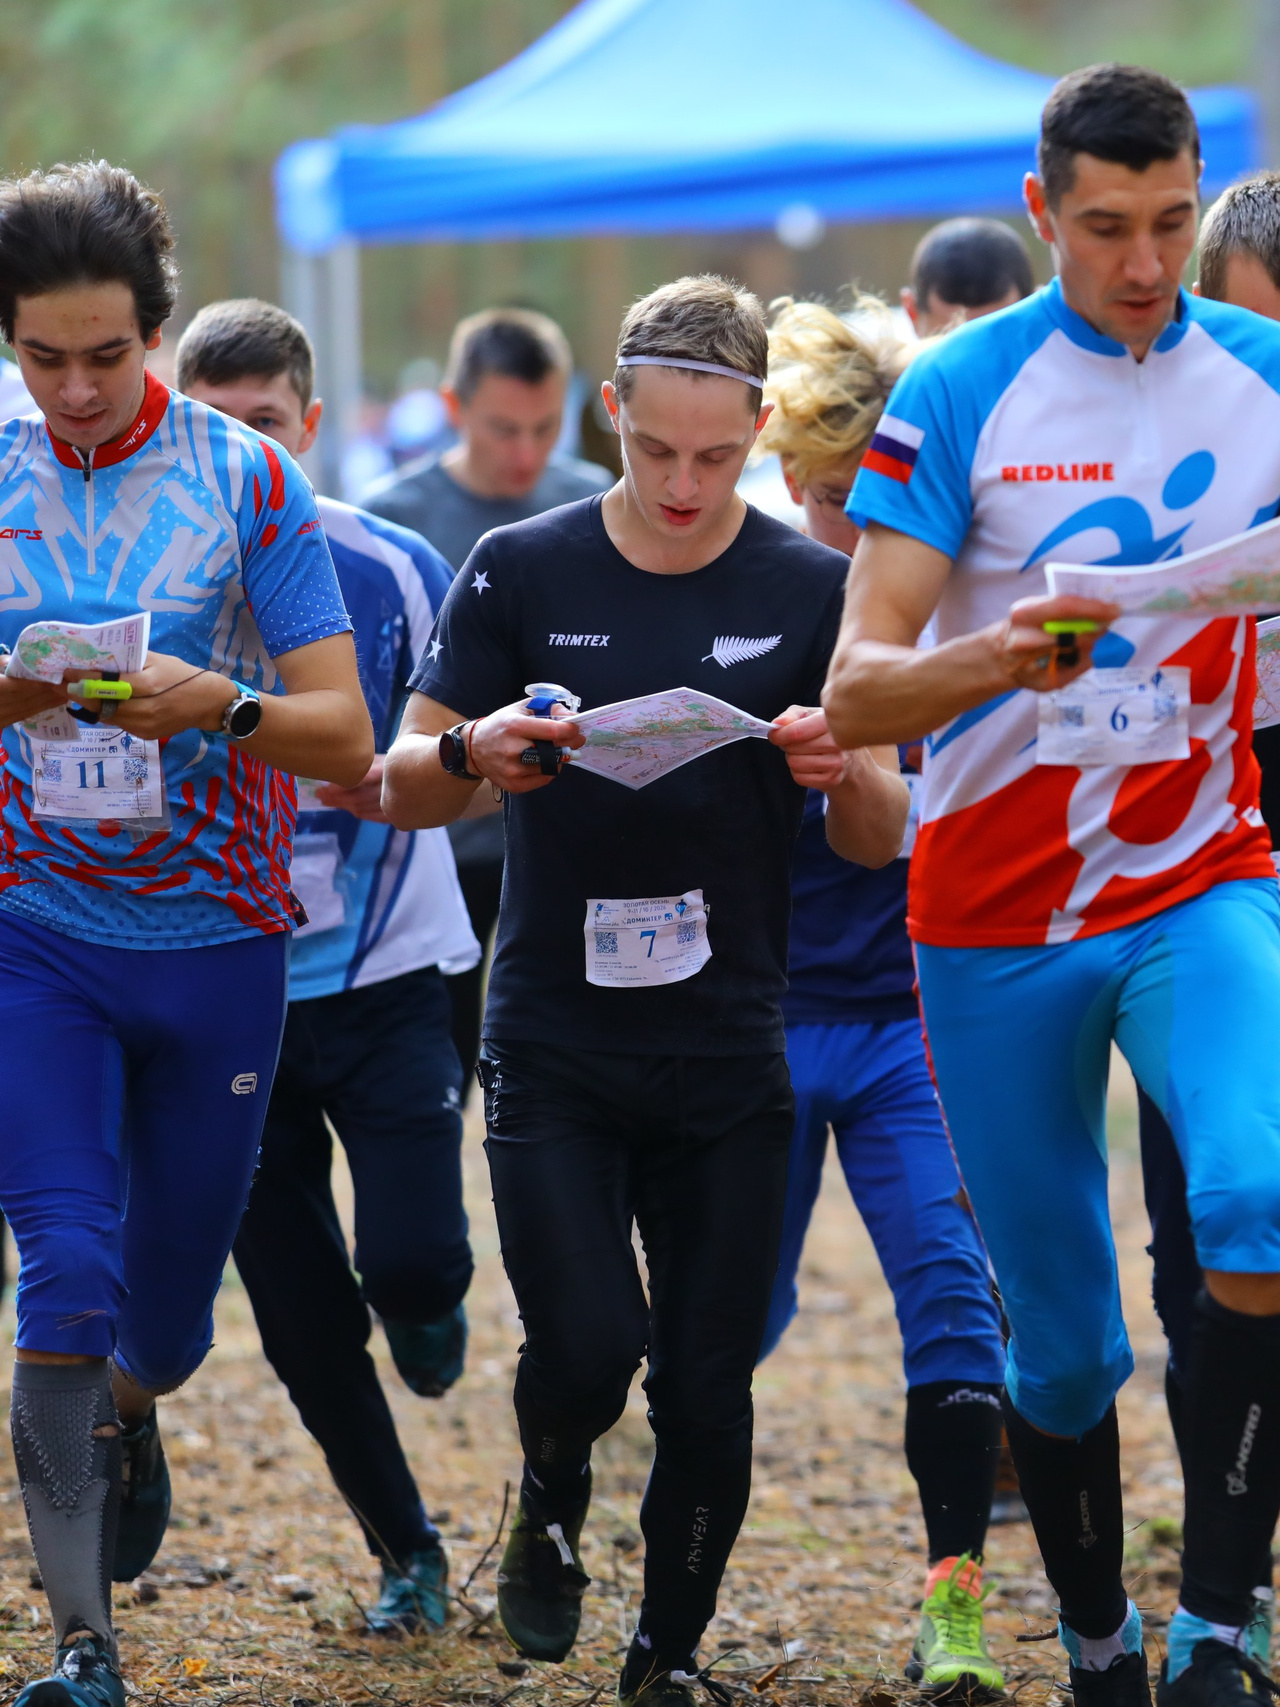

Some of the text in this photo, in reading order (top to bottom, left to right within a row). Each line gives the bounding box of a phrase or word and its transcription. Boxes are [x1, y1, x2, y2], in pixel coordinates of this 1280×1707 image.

[1001, 461, 1115, 482] REDLINE
[548, 633, 611, 647] TRIMTEX
[1110, 700, 1128, 732] 6
[76, 760, 108, 789] 11
[627, 914, 662, 925] ДОМИНТЕР
[639, 930, 657, 958] 7
